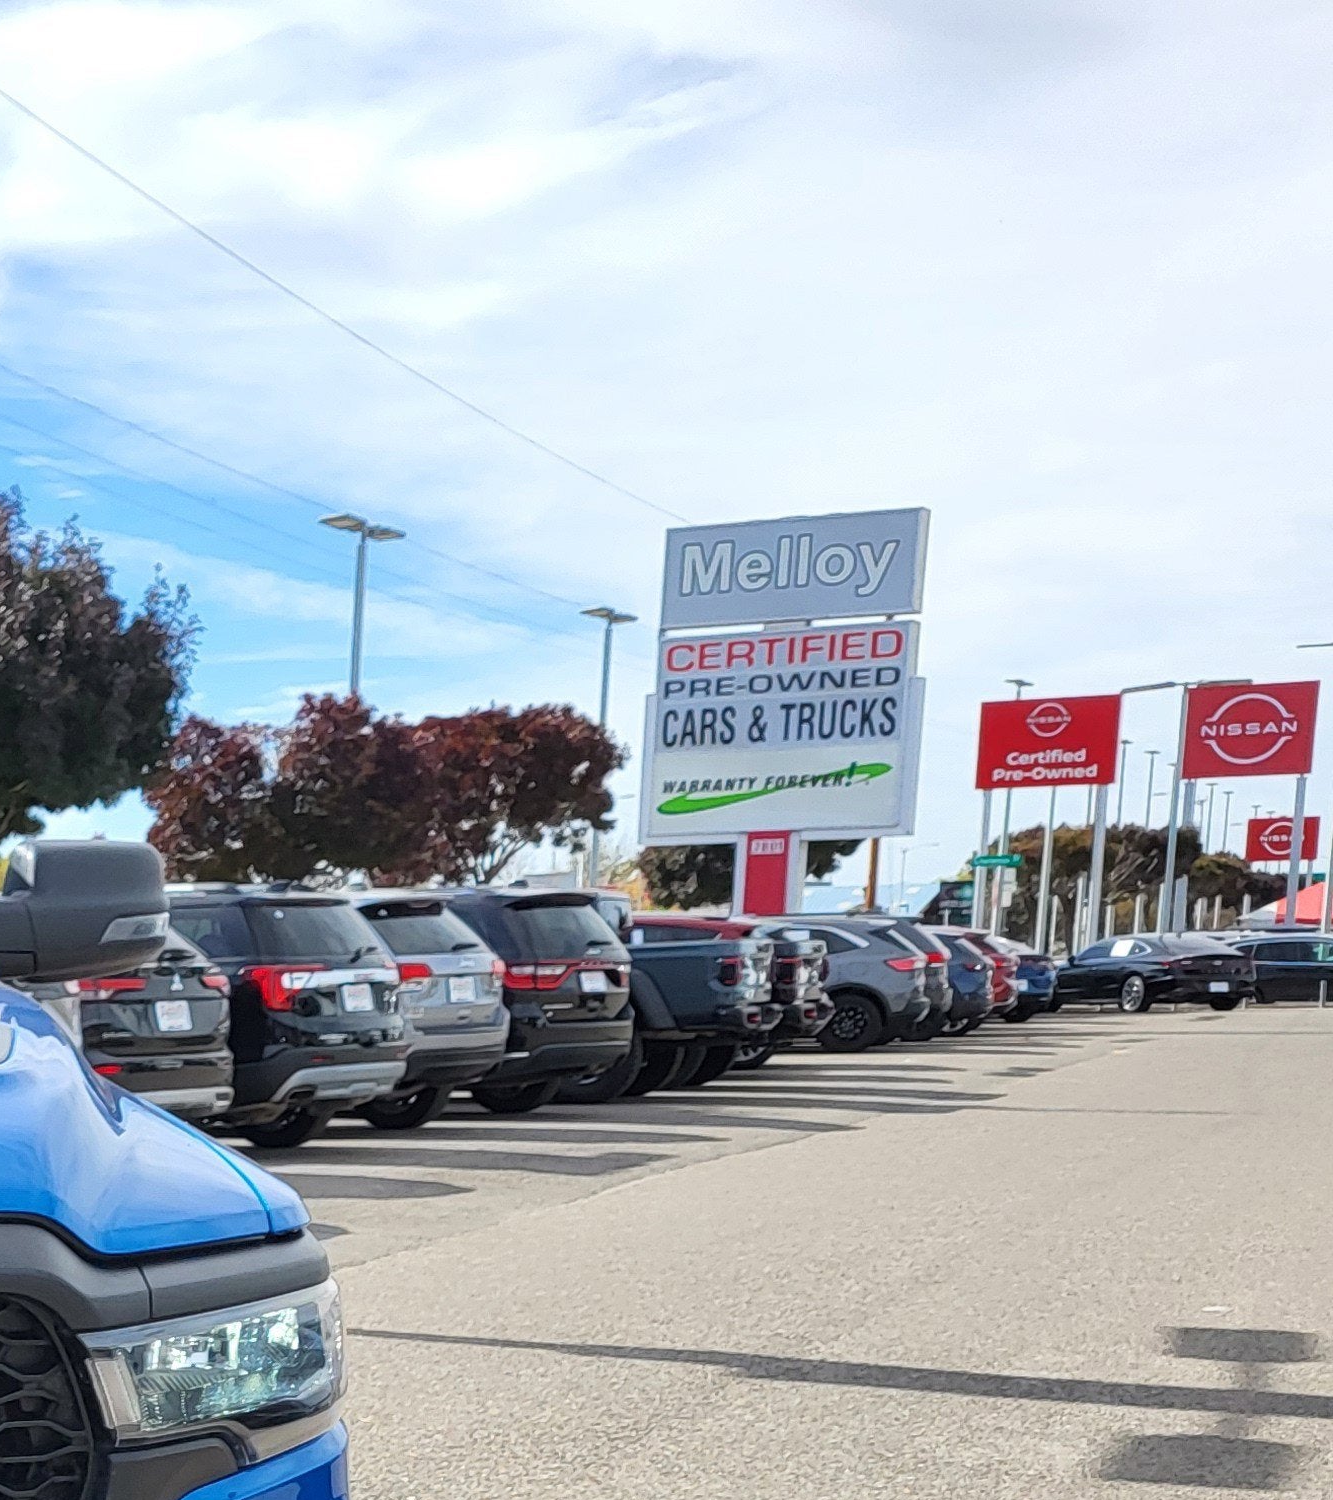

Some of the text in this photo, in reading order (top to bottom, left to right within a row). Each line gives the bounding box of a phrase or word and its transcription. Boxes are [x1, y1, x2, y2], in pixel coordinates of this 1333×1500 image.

[679, 533, 900, 597] Melloy
[665, 629, 904, 673] CERTIFIED
[663, 666, 901, 699] PRE-OWNED
[662, 696, 898, 748] CARS & TRUCKS
[1200, 721, 1298, 738] NISSAN
[1005, 748, 1087, 766] Certified
[662, 775, 759, 794] WARRANTY
[992, 763, 1098, 782] Pre-Owned
